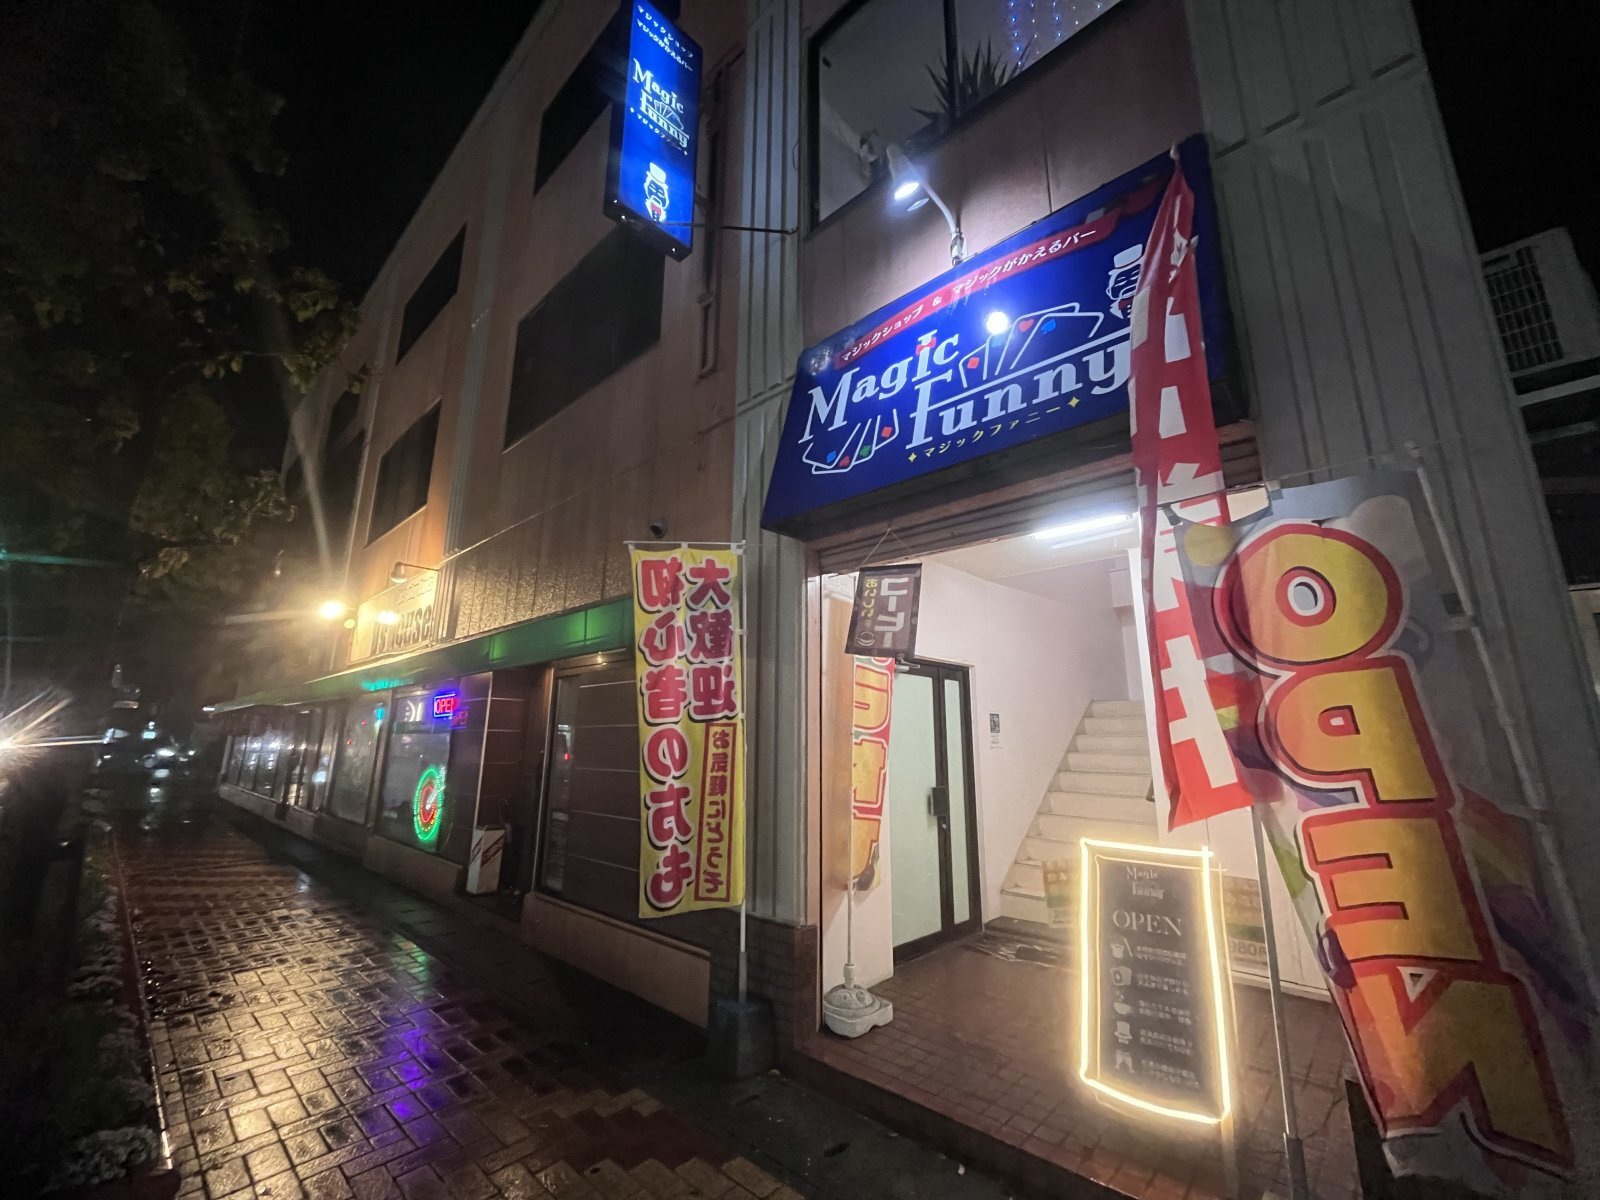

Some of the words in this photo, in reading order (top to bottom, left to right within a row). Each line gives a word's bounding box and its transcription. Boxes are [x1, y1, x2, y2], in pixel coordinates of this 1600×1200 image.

[633, 58, 684, 114] Magic
[640, 89, 690, 148] Funny
[841, 304, 925, 361] マジックショップ
[931, 296, 943, 307] &
[952, 229, 1097, 294] マジックがかえるバー
[798, 328, 960, 444] Magic
[906, 333, 1132, 450] Funny
[923, 406, 1061, 458] マジックファニー
[1112, 910, 1182, 937] OPEN
